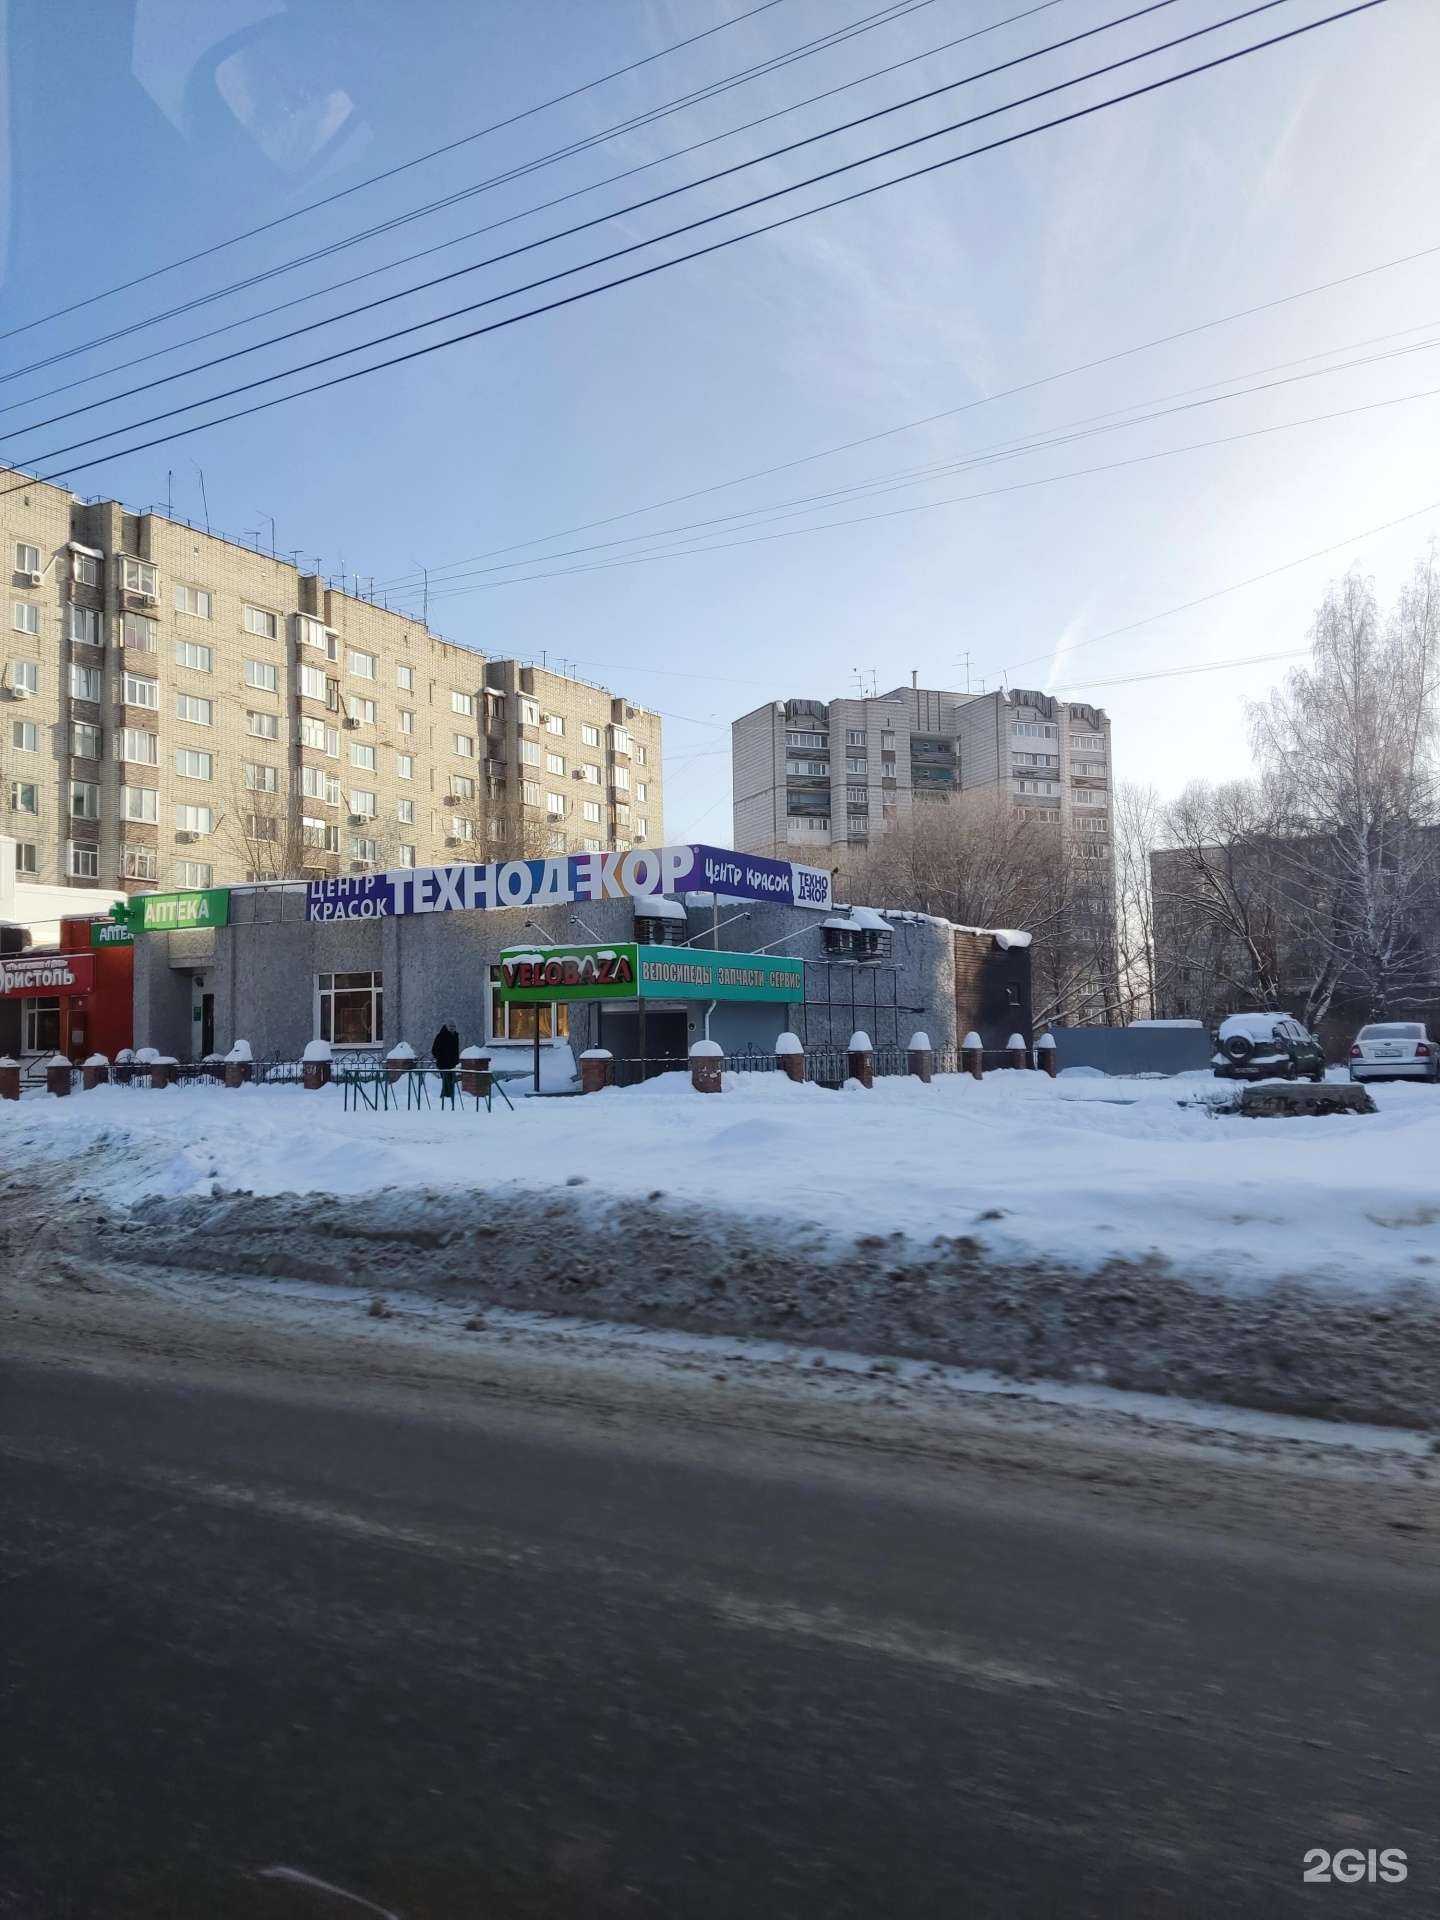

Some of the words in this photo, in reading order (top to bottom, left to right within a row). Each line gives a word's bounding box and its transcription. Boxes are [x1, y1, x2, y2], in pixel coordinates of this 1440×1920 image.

[311, 876, 375, 902] ЦЕНТР
[386, 845, 694, 915] ТЕХНОДЕКОР
[798, 871, 828, 890] ТЕХНО
[798, 886, 827, 903] ДЕКОР
[144, 899, 210, 923] АПТЕКА
[310, 897, 388, 922] КРАСОК
[99, 924, 134, 942] АПТЕ
[502, 955, 633, 988] VELOBAZA
[642, 961, 712, 985] ВЕЛОСИПЕДЫ
[718, 967, 764, 987] ЗАПЧАСТИ
[770, 971, 801, 988] СЕРВИС
